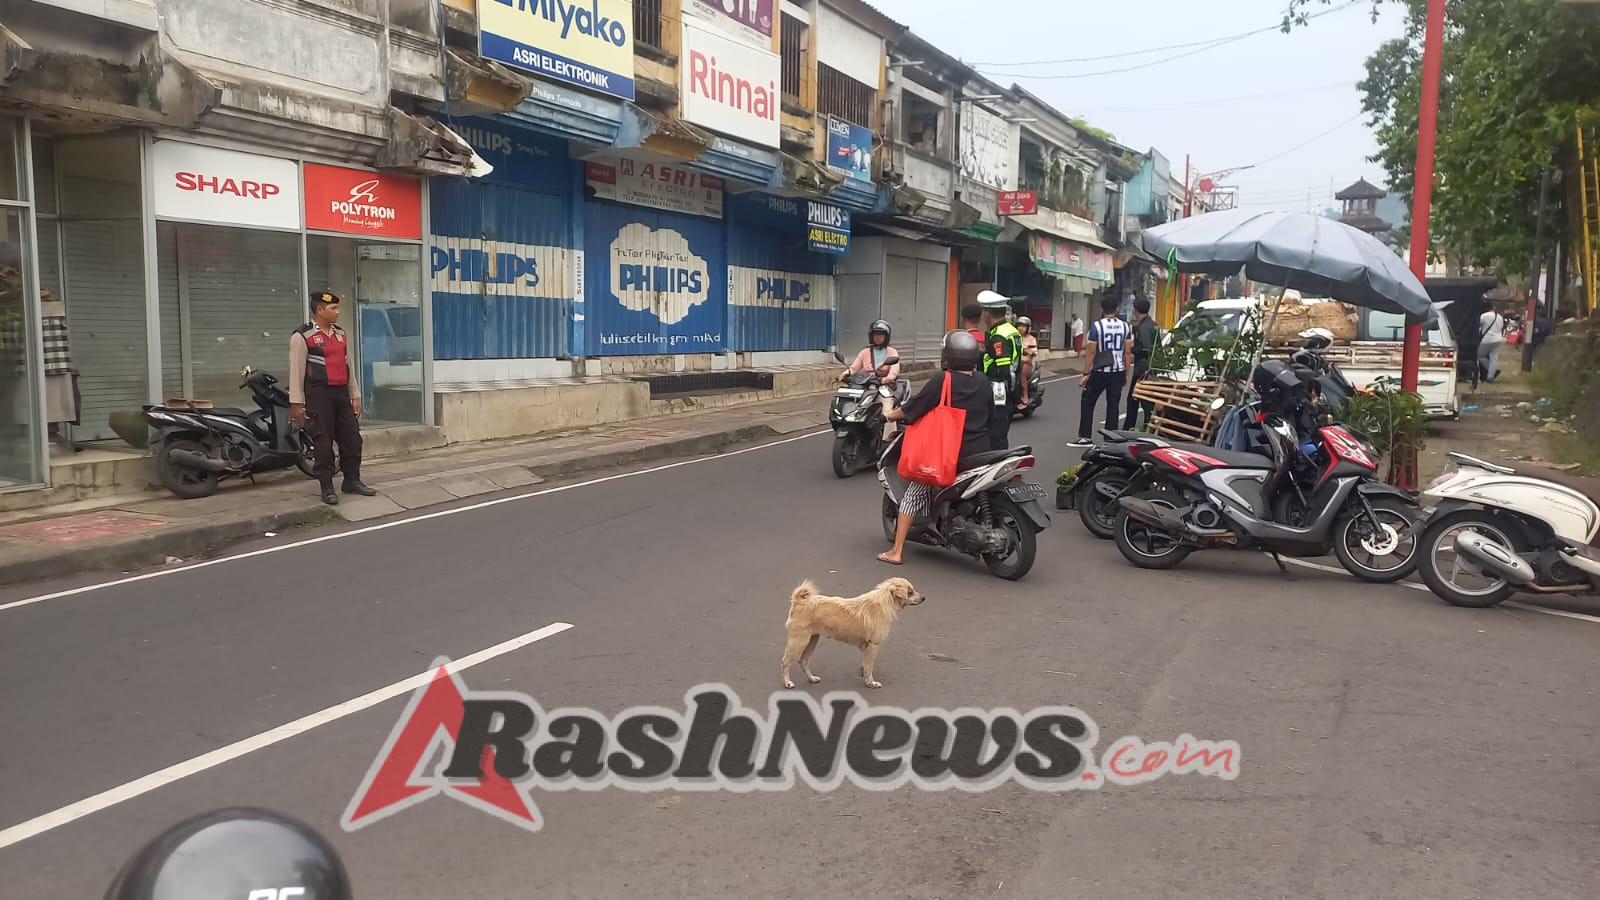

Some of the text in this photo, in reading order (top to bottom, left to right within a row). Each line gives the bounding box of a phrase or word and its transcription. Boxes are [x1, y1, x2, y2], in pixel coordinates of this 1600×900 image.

[513, 47, 609, 89] ASRI ELEKTRONIK
[690, 49, 774, 121] Rinnai
[175, 171, 280, 199] SHARP
[640, 163, 697, 187] ASRI
[331, 201, 395, 220] POLYTRON
[808, 201, 842, 227] PHILIPS
[809, 228, 848, 246] ASRI ELECTRO
[1105, 333, 1125, 351] 20
